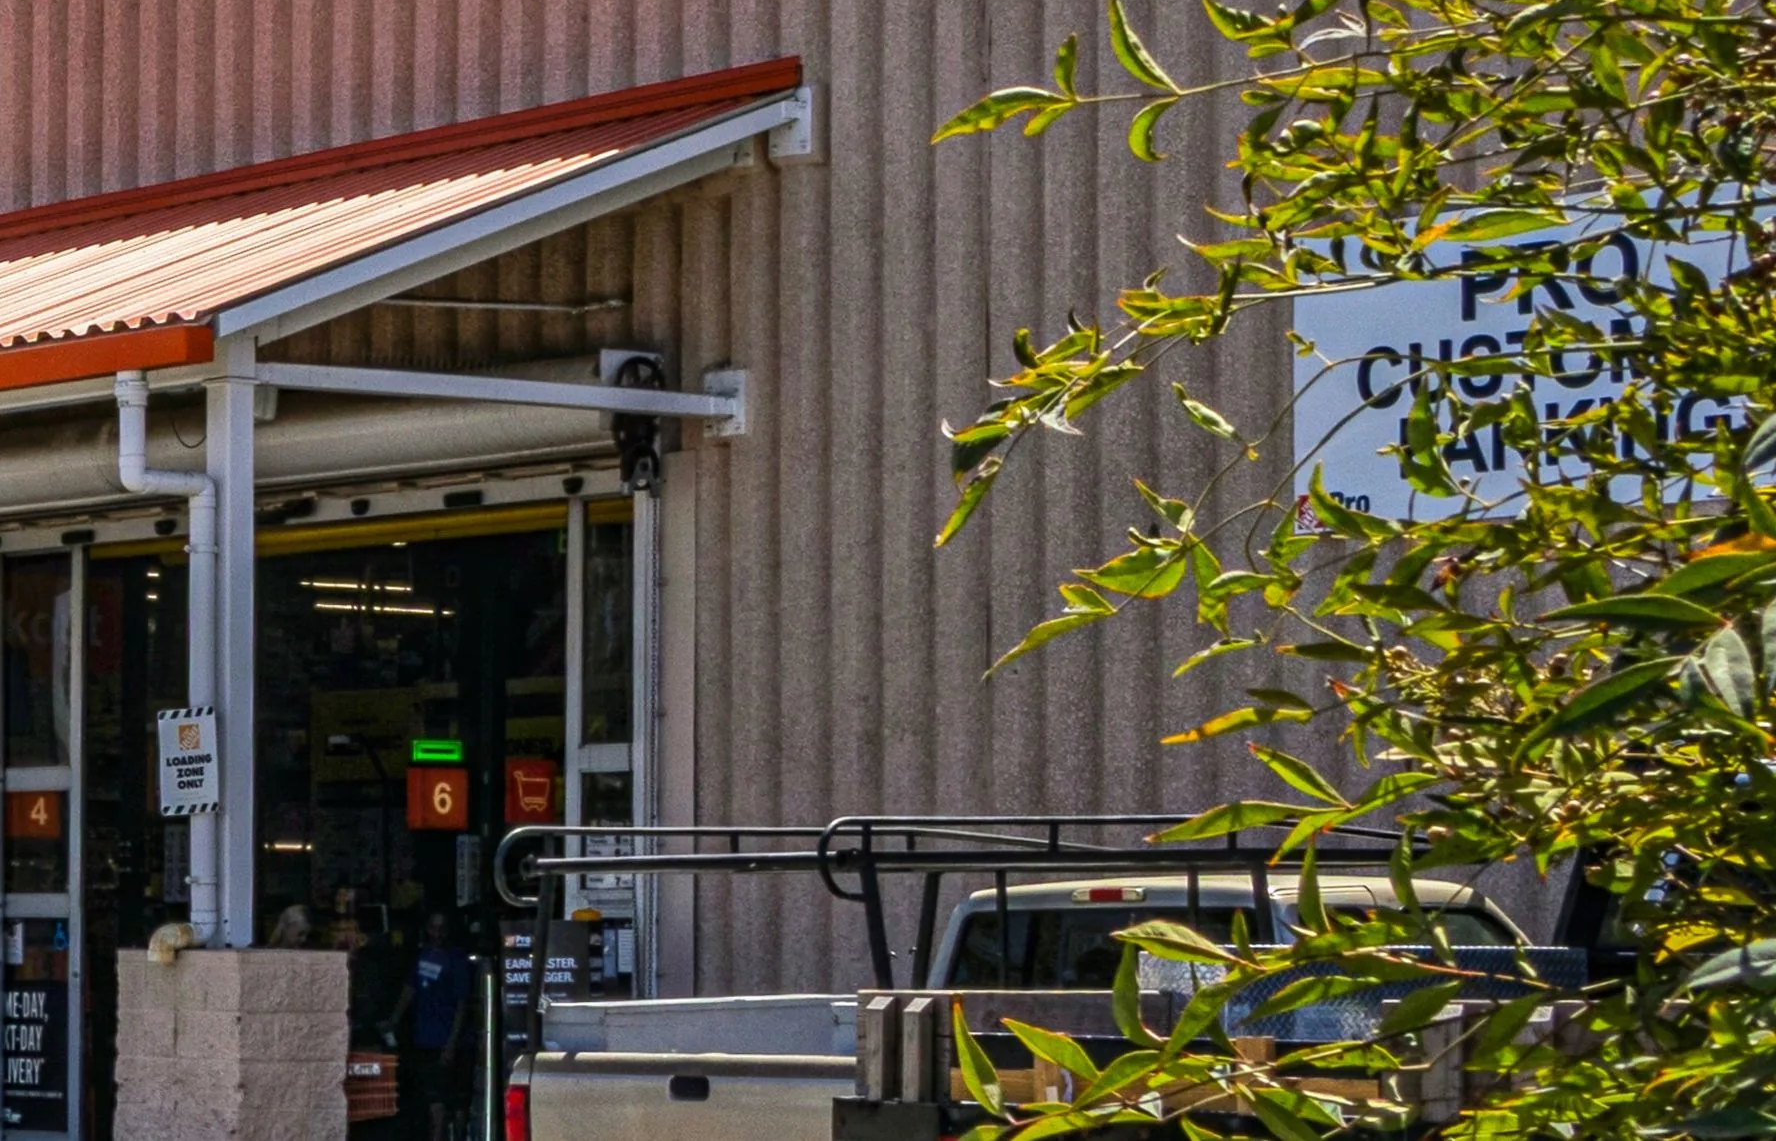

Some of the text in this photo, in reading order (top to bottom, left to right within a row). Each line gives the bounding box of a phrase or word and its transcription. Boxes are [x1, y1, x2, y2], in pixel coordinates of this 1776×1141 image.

[166, 753, 213, 767] LOADING
[176, 766, 205, 778] ZONE
[178, 778, 205, 790] ONLY
[432, 782, 454, 815] 6
[30, 797, 48, 825] 4
[504, 957, 578, 969] EARN STER.
[504, 971, 576, 983] SAVE GGER.
